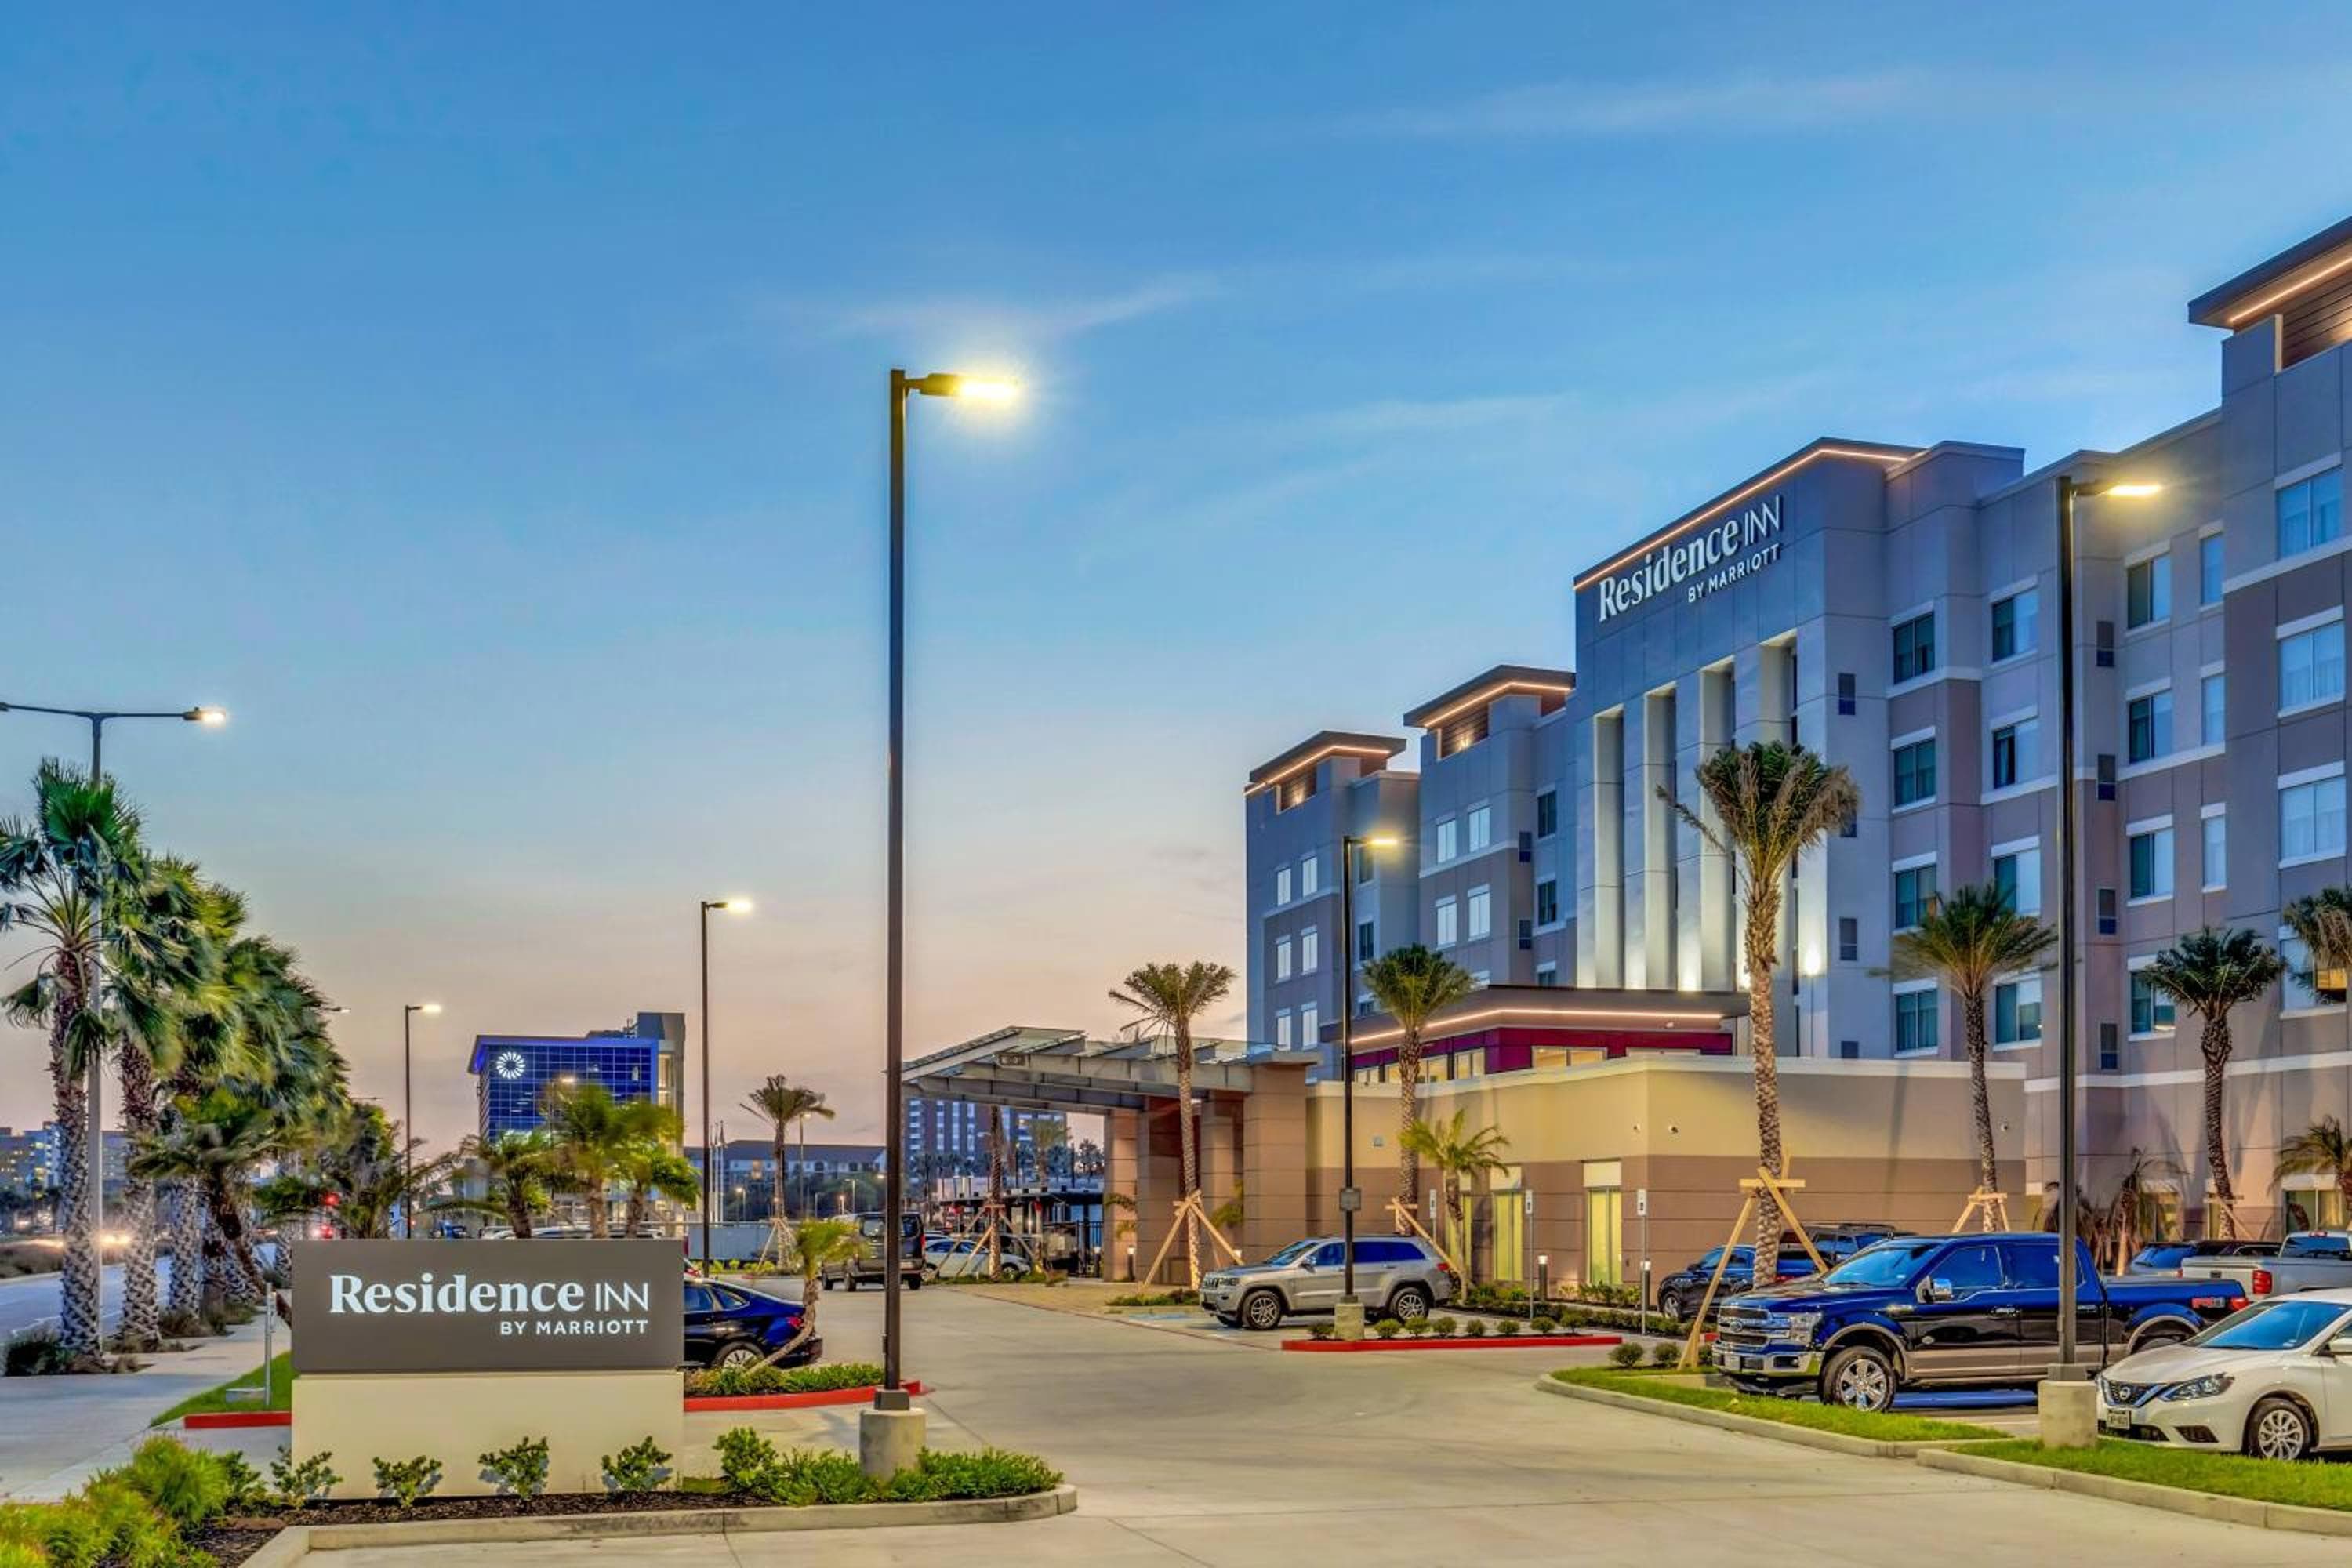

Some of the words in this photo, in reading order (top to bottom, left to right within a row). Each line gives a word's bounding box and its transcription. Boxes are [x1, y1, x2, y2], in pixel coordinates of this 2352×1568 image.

[1599, 519, 1738, 622] Residence
[1744, 495, 1780, 546] INN
[1688, 582, 1705, 603] BY
[1708, 543, 1780, 593] MARRIOTT
[329, 1272, 585, 1314] Residence
[595, 1282, 649, 1312] INN
[500, 1321, 528, 1335] BY
[535, 1319, 648, 1335] MARRIOTT
